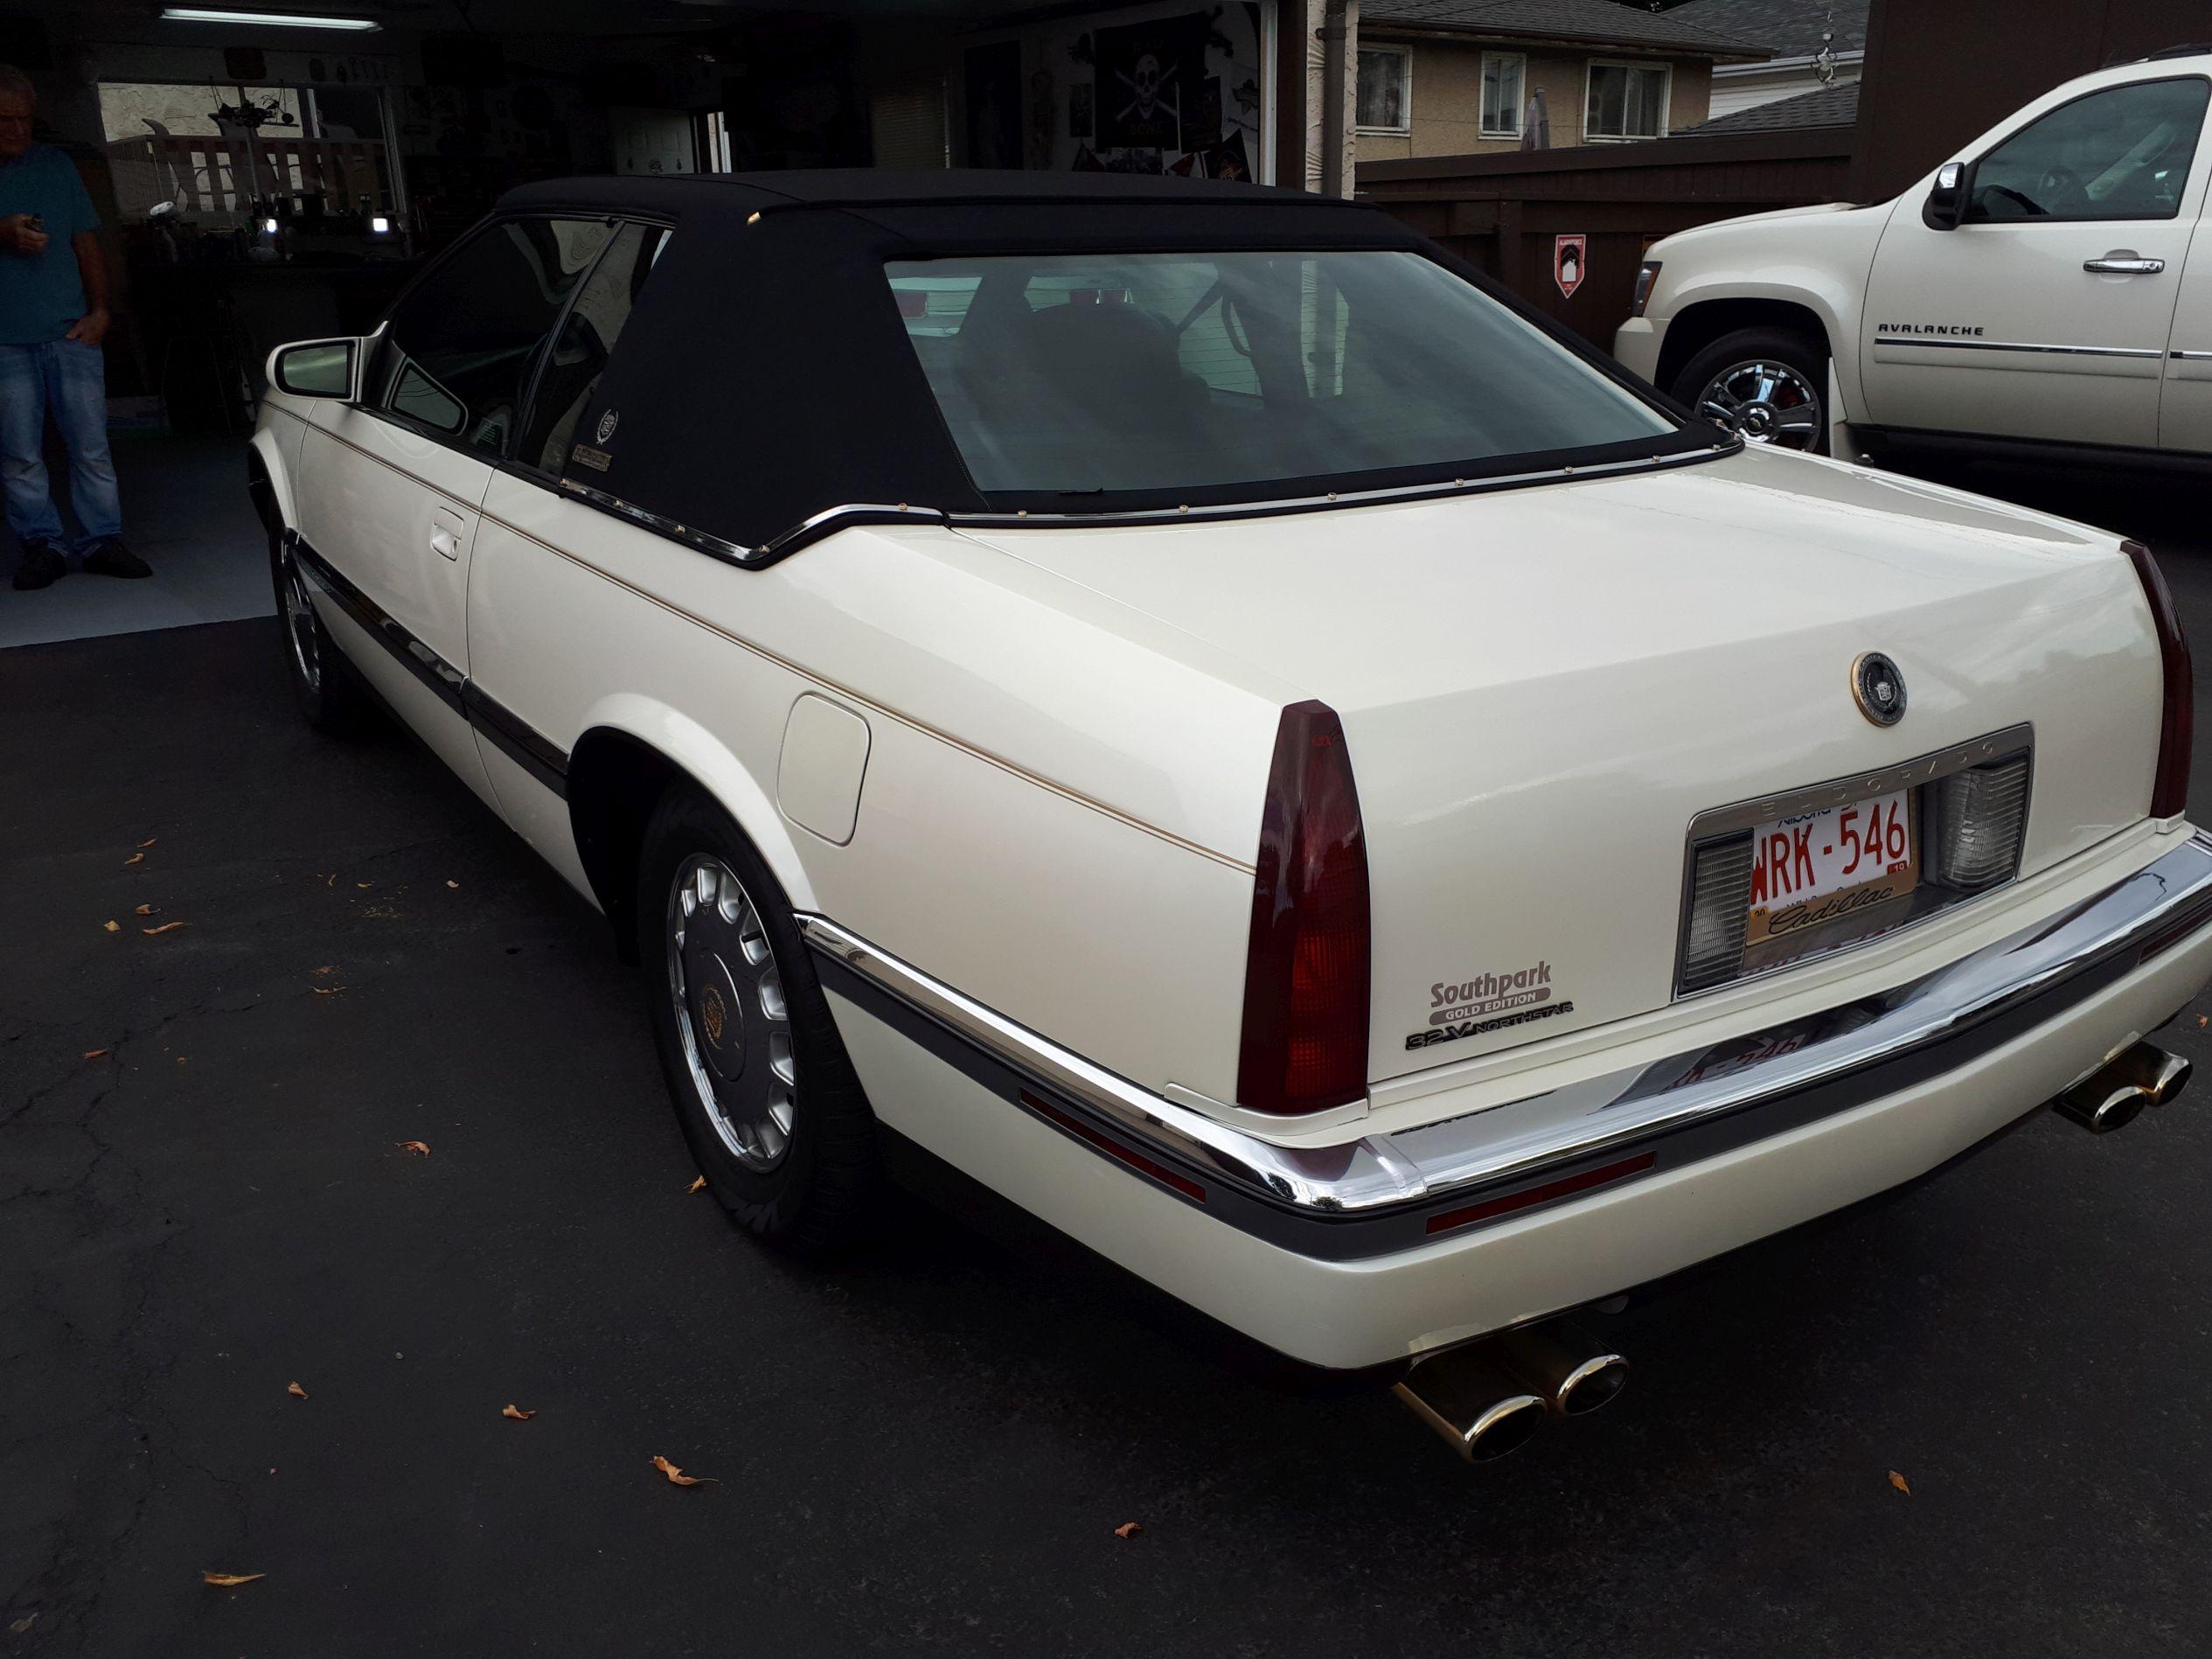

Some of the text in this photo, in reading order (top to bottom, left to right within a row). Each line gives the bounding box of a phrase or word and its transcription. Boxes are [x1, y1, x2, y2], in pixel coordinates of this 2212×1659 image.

[1878, 324, 1985, 335] AVALANCHE
[1749, 799, 1906, 905] WRK-546
[1769, 886, 1896, 935] Cadillac
[1431, 960, 1551, 1007] Southpark
[1445, 992, 1536, 1021] GOLD EDITION
[1474, 1000, 1575, 1034] NORTHSTAR
